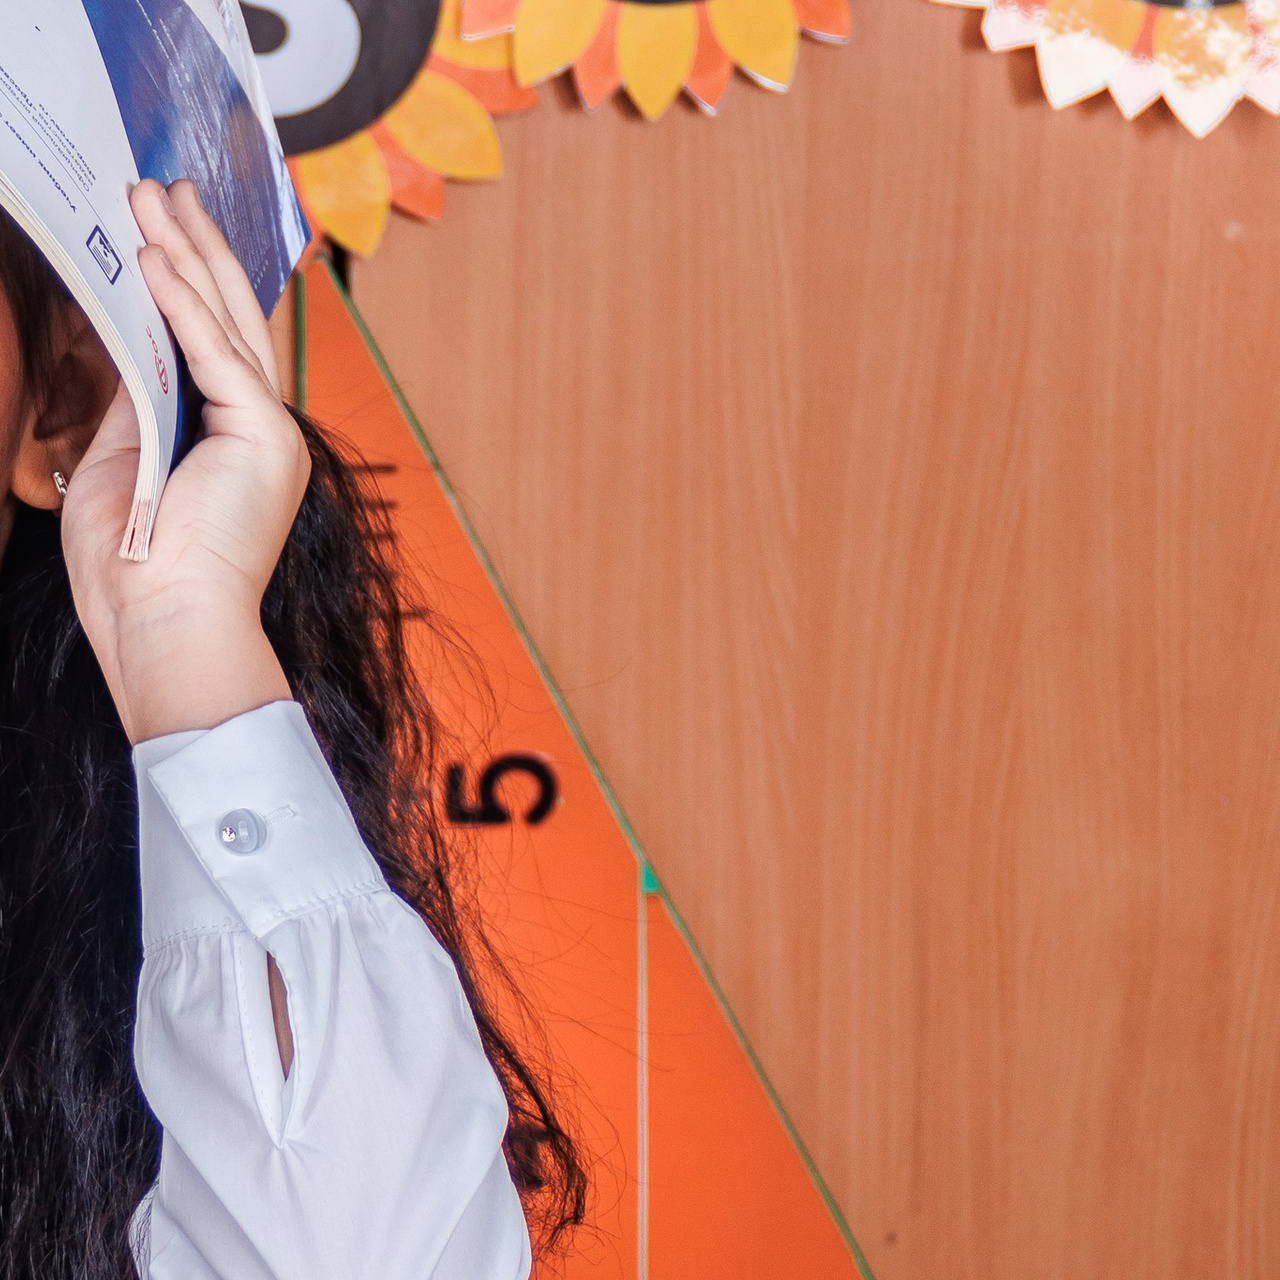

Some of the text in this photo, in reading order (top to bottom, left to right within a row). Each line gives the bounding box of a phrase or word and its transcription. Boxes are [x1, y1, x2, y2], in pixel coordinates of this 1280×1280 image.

[3, 120, 37, 159] имеет
[37, 158, 78, 215] Учебник
[446, 753, 558, 827] 5
